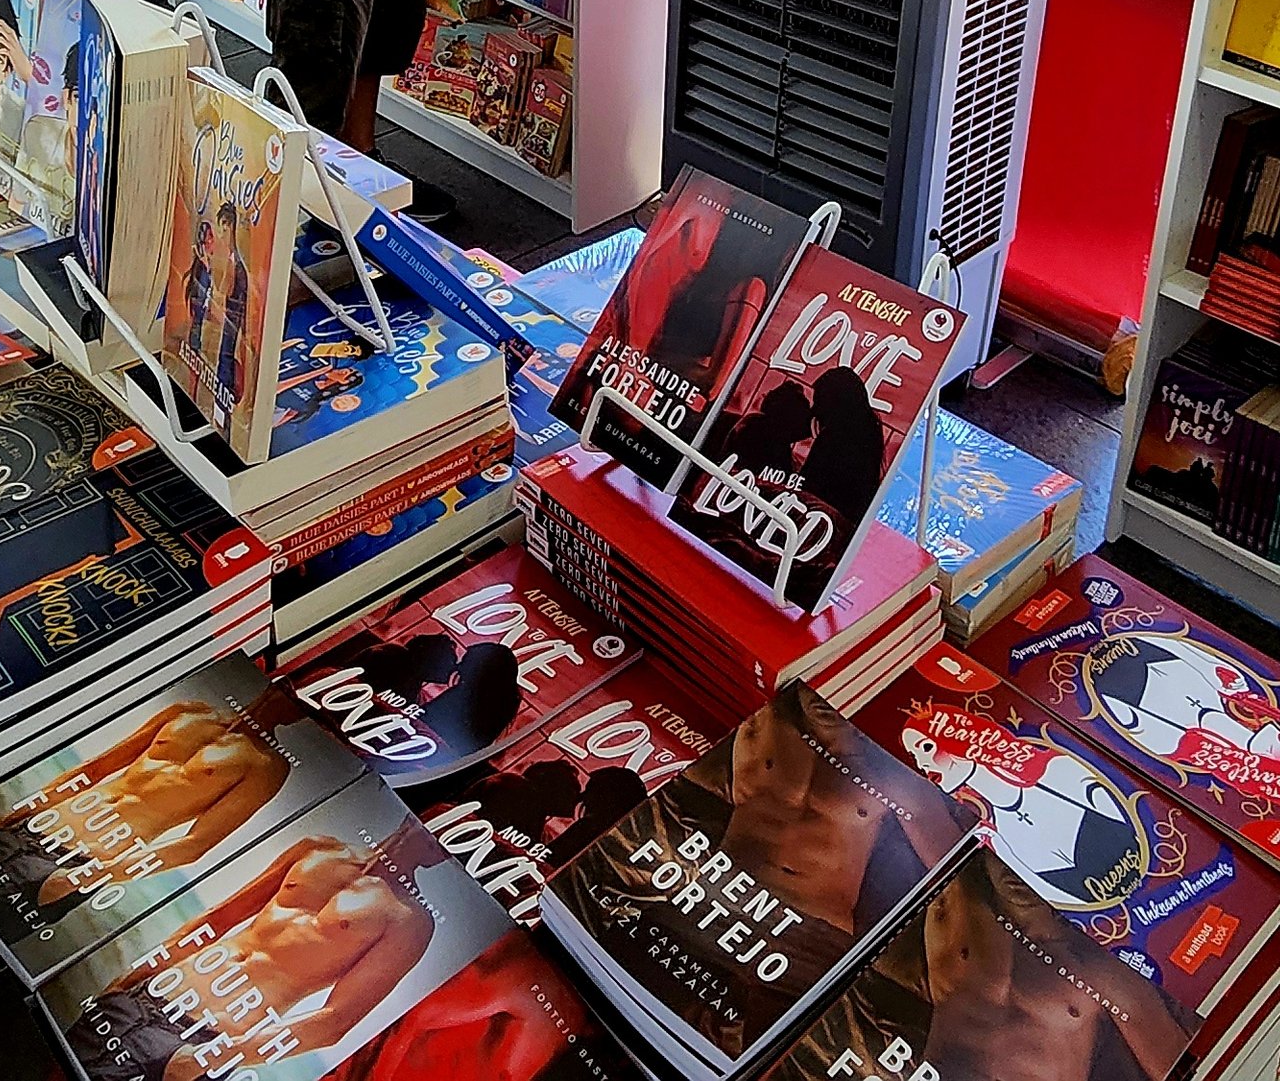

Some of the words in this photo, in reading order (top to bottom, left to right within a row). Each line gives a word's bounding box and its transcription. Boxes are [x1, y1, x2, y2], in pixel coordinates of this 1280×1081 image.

[219, 121, 245, 165] Blue
[732, 209, 775, 236] BASTARDS
[385, 237, 414, 268] BLUE
[407, 257, 441, 291] DAISIES
[434, 280, 461, 307] PART
[453, 295, 464, 310] 2
[838, 284, 854, 303] AI
[855, 288, 912, 328] TENSHI
[178, 339, 237, 409] ARROWHEADS
[600, 335, 702, 404] ALESSANDRE
[769, 292, 922, 413] LOVE
[862, 331, 876, 348] TO
[587, 358, 687, 431] FORTEJO
[1161, 384, 1235, 435] simply
[604, 422, 662, 466] BUNCARAS
[758, 465, 786, 486] AND
[786, 472, 806, 490] BE
[295, 538, 327, 563] BLUE
[329, 520, 372, 548] DAISIES
[372, 504, 401, 528] PART
[420, 467, 473, 500] ARROWHEADS
[323, 504, 368, 534] DAISIES
[370, 492, 399, 513] PART
[416, 455, 470, 486] ARROWHEADS
[548, 493, 575, 523] ZERO
[576, 515, 611, 554] SEVEN
[693, 452, 834, 562] LOVED
[542, 514, 572, 541] ZERO
[572, 532, 608, 571] SEVEN
[554, 536, 582, 562] ZERO
[584, 556, 619, 594] SEVEN
[34, 577, 80, 649] KNOCK!
[73, 560, 153, 609] KNOCK,
[555, 552, 584, 580] ZERO
[586, 575, 620, 612] SEVEN
[432, 583, 585, 693] LOVE
[223, 693, 258, 732] FORTEJO
[257, 729, 303, 770] BASTARDS
[294, 667, 439, 763] LOVED
[377, 687, 404, 711] AND
[402, 699, 426, 721] BE
[927, 711, 1037, 763] Heartless
[801, 732, 851, 780] FORTEJO
[852, 774, 914, 822] BASTARDS
[964, 740, 1026, 774] Queen
[11, 791, 125, 912] FORTEJO
[56, 772, 166, 883] FOURTH
[497, 824, 526, 850] AND
[526, 842, 553, 863] BE
[356, 827, 400, 879] FORTEJO
[398, 875, 447, 926] BASTARDS
[628, 838, 790, 984] FORTEJO
[676, 829, 804, 938] BRENT
[1084, 848, 1144, 904] Queens
[6, 887, 55, 943] ALEJO
[588, 883, 640, 940] LEIZL
[646, 943, 739, 1023] RAZALAN
[648, 924, 729, 997] CARAMEL)
[995, 914, 1055, 968] FORTEJO
[1057, 966, 1132, 1024] BASTARDS
[178, 921, 299, 1067] FOURTH
[530, 983, 581, 1045] FORTEJO
[79, 993, 131, 1067] MIDGE
